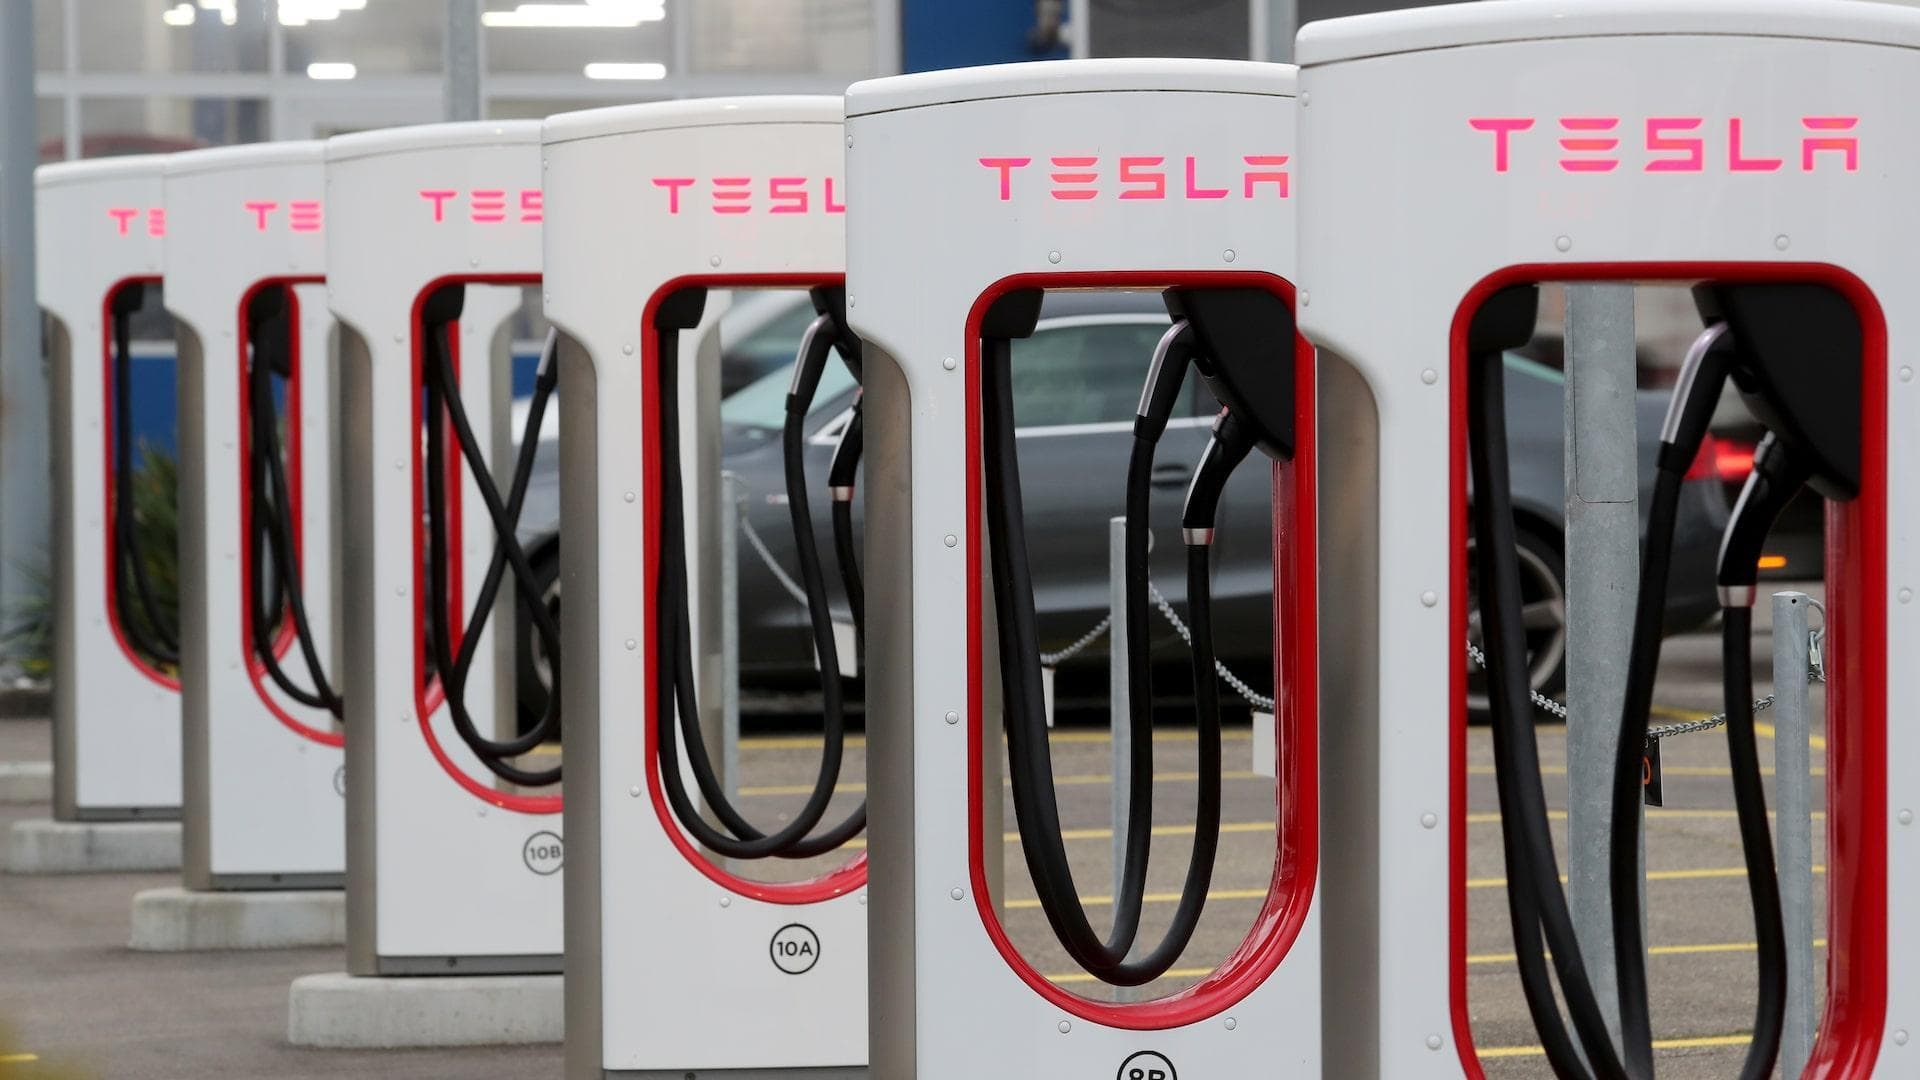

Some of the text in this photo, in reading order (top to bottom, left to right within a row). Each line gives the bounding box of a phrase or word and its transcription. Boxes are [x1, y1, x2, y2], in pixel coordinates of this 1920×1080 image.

[1467, 115, 1860, 174] TESLA
[651, 176, 846, 215] TESL
[977, 154, 1290, 201] TESLA
[530, 845, 561, 861] 10B
[777, 941, 813, 957] 10A
